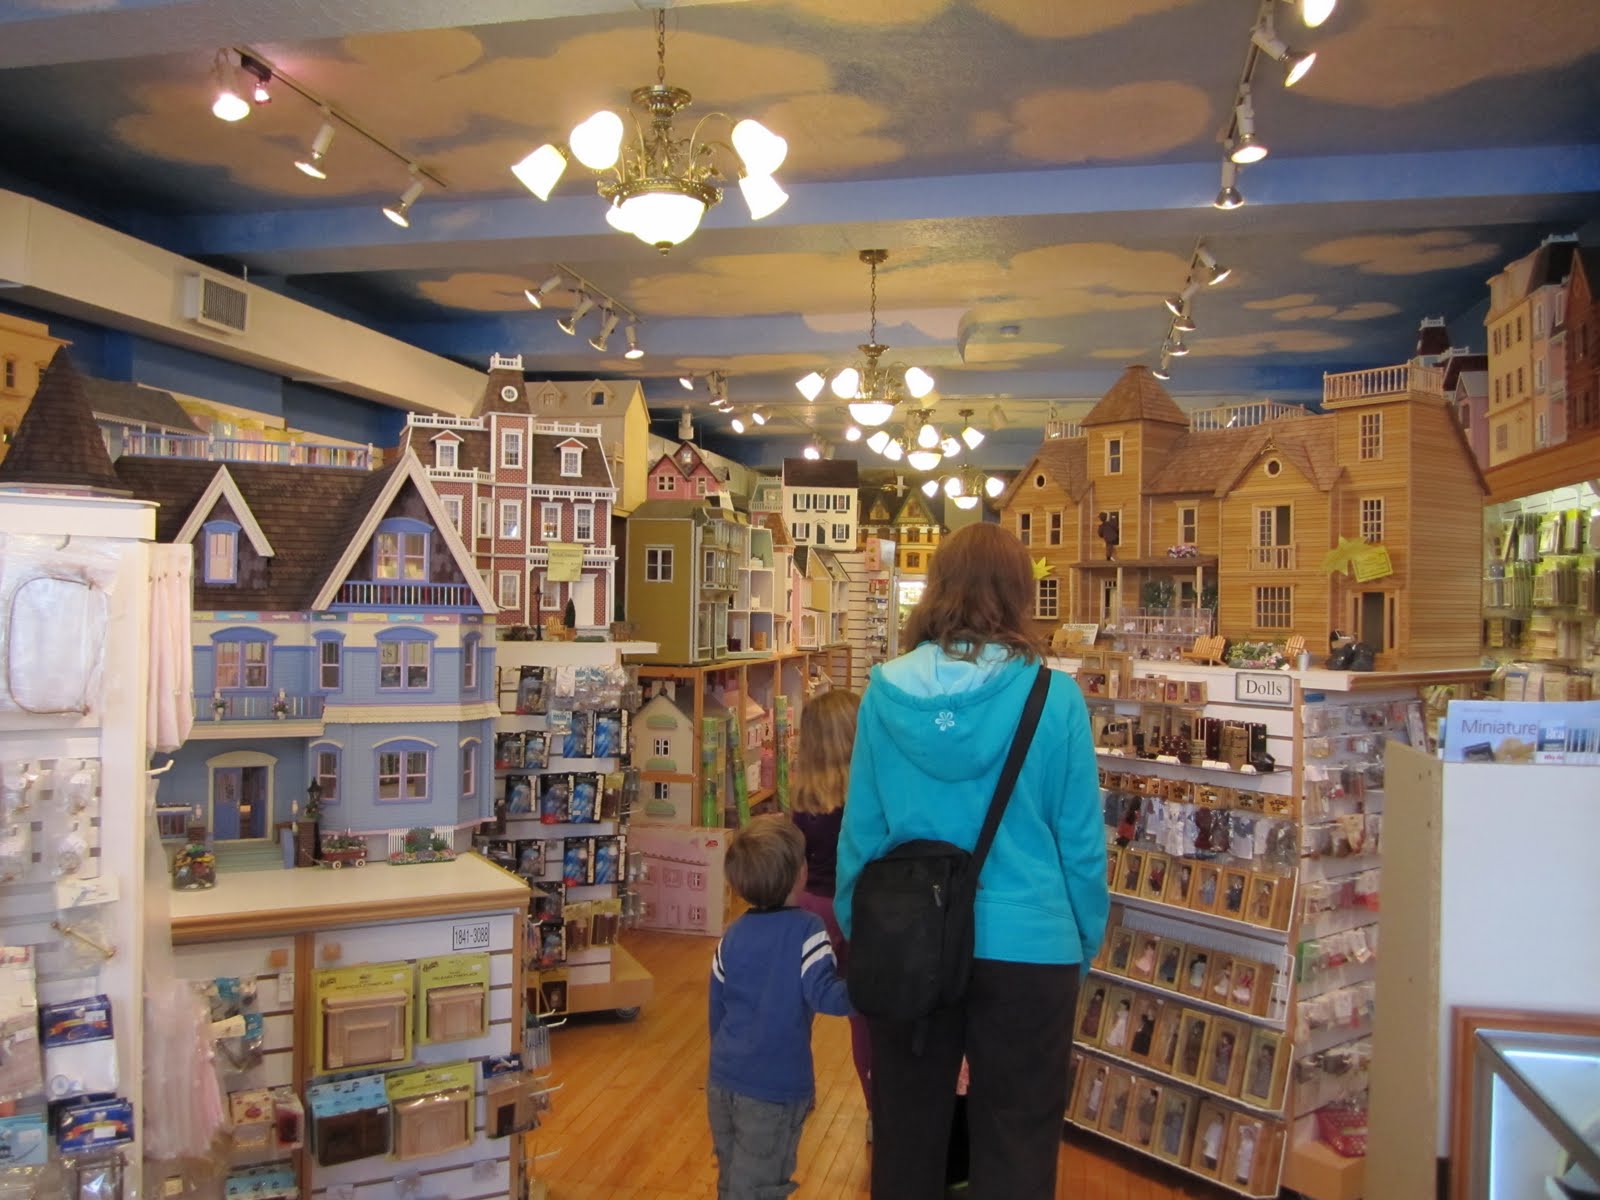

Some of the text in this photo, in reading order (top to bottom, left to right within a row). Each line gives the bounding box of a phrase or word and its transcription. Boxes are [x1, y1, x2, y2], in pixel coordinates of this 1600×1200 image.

[1246, 679, 1282, 696] Dolls
[1461, 719, 1537, 735] Miniature
[455, 926, 488, 945] 1841-3088
